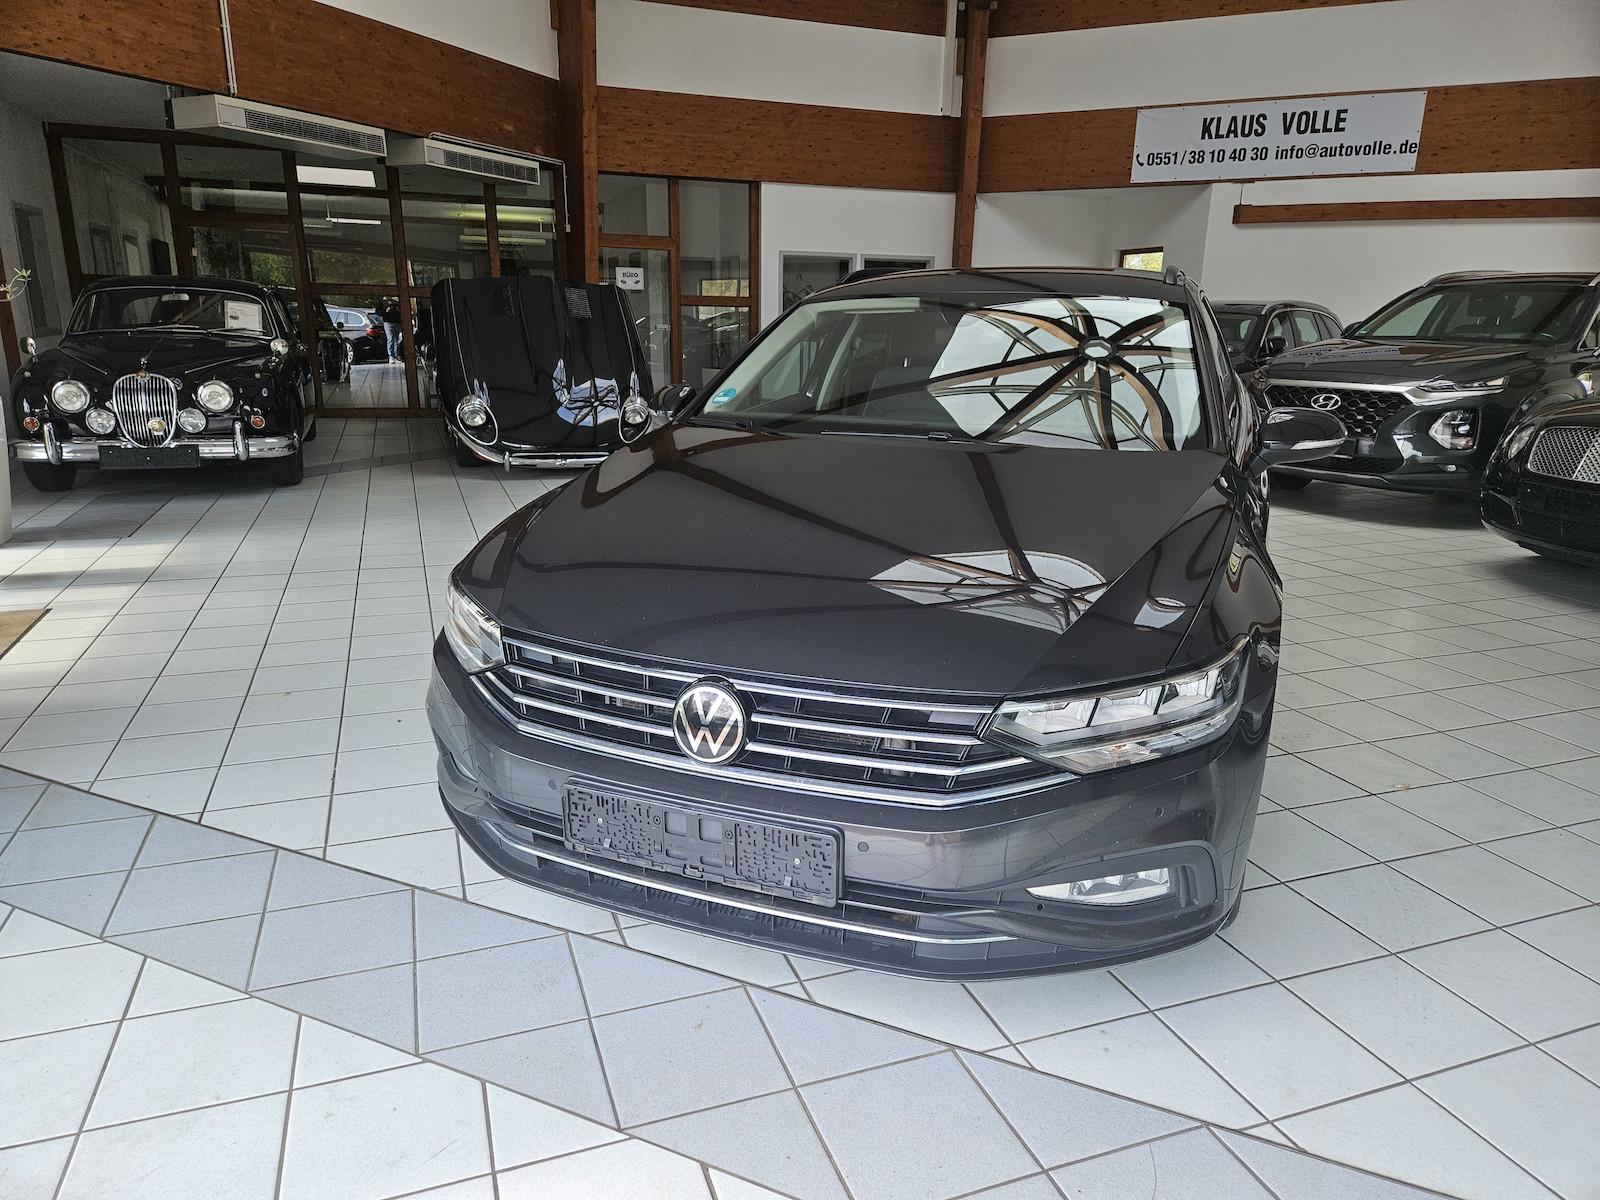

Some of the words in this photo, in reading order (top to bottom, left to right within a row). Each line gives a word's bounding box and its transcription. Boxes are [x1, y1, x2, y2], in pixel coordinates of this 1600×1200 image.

[1201, 113, 1267, 140] KLAUS
[1282, 109, 1348, 135] VOLLE
[1209, 149, 1226, 163] 10
[1229, 148, 1247, 162] 40
[1250, 147, 1269, 161] 30
[1275, 139, 1418, 160] info@autovolle.de
[675, 688, 743, 761] VW
